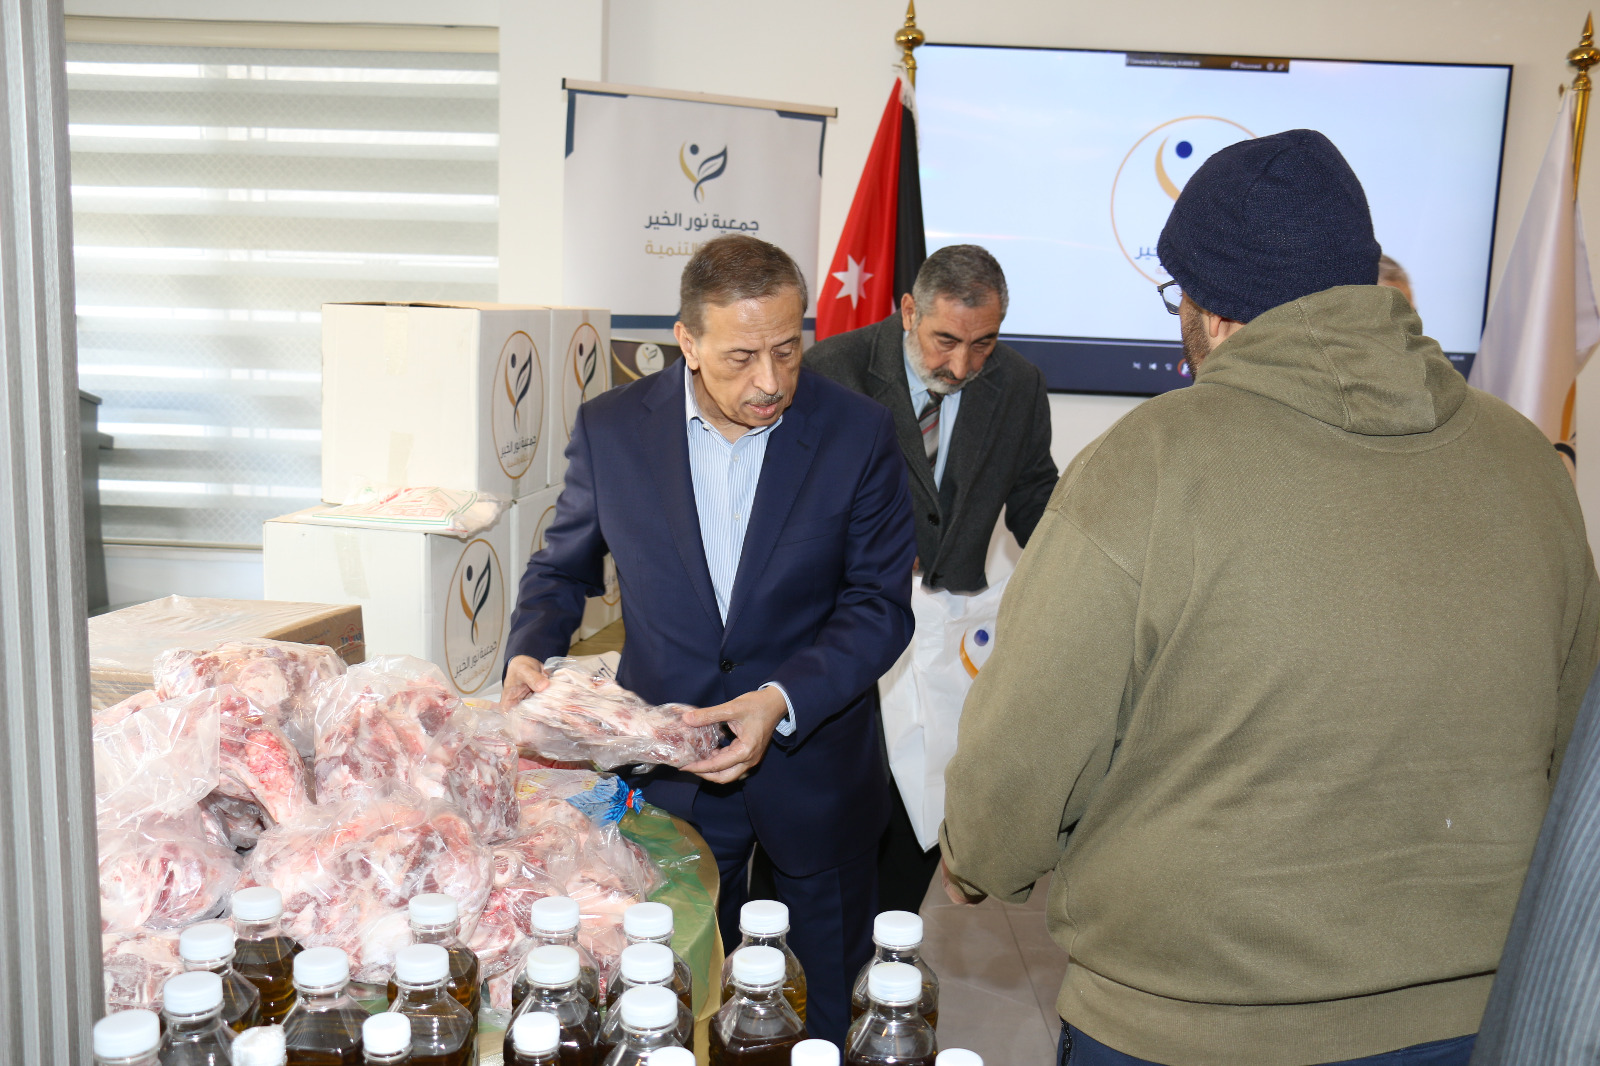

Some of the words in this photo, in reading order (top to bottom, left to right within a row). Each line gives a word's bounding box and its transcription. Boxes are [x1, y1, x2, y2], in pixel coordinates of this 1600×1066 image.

[644, 211, 682, 230] الخير
[684, 213, 708, 231] نور
[712, 214, 759, 235] جمعية
